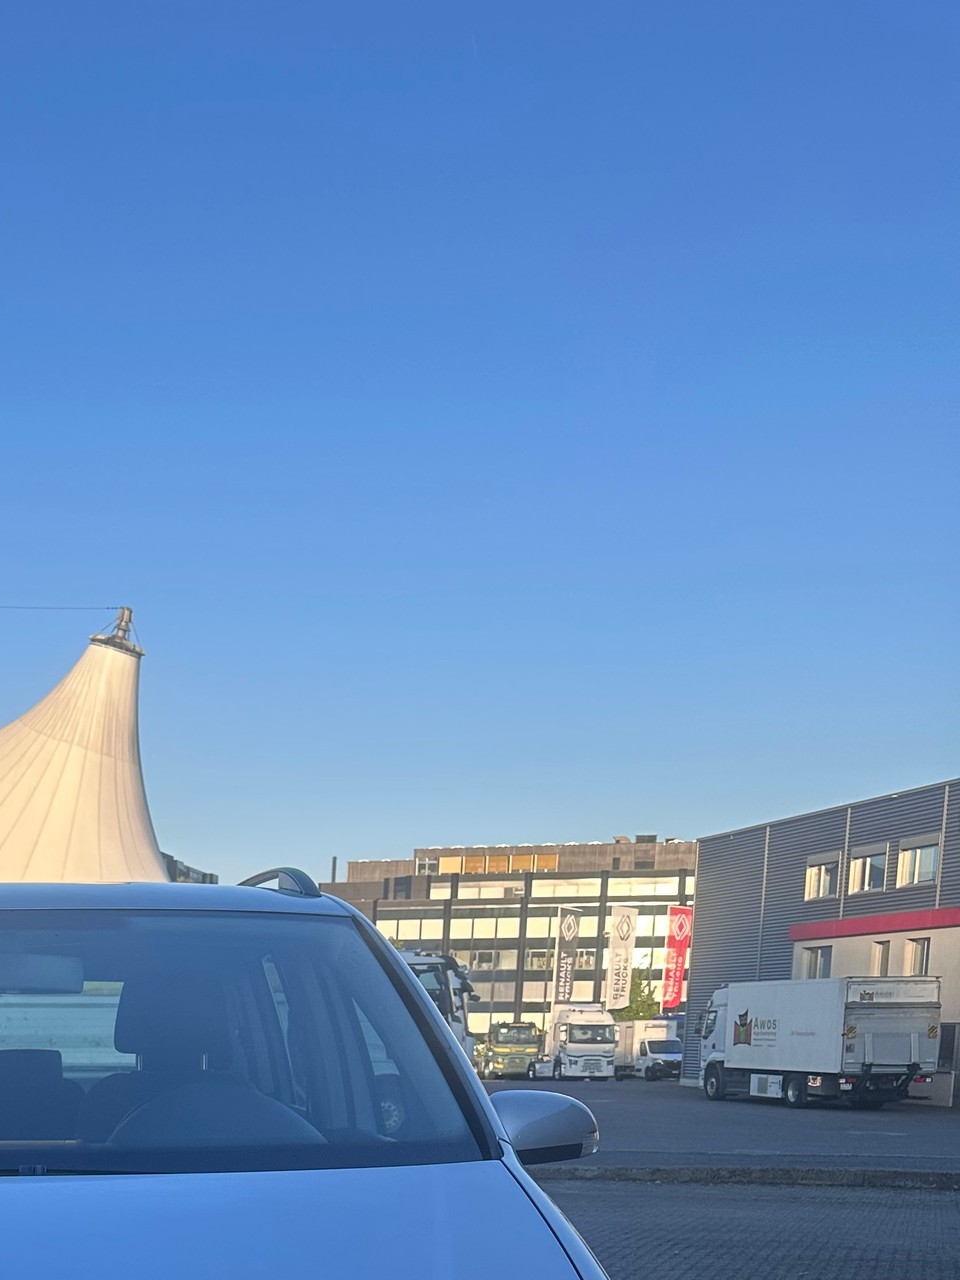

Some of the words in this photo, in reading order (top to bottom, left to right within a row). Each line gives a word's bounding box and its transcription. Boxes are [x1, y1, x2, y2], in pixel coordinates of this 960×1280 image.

[558, 951, 568, 1000] RENAULT
[613, 952, 623, 1000] RENAULT
[619, 957, 628, 998] TRUCKS
